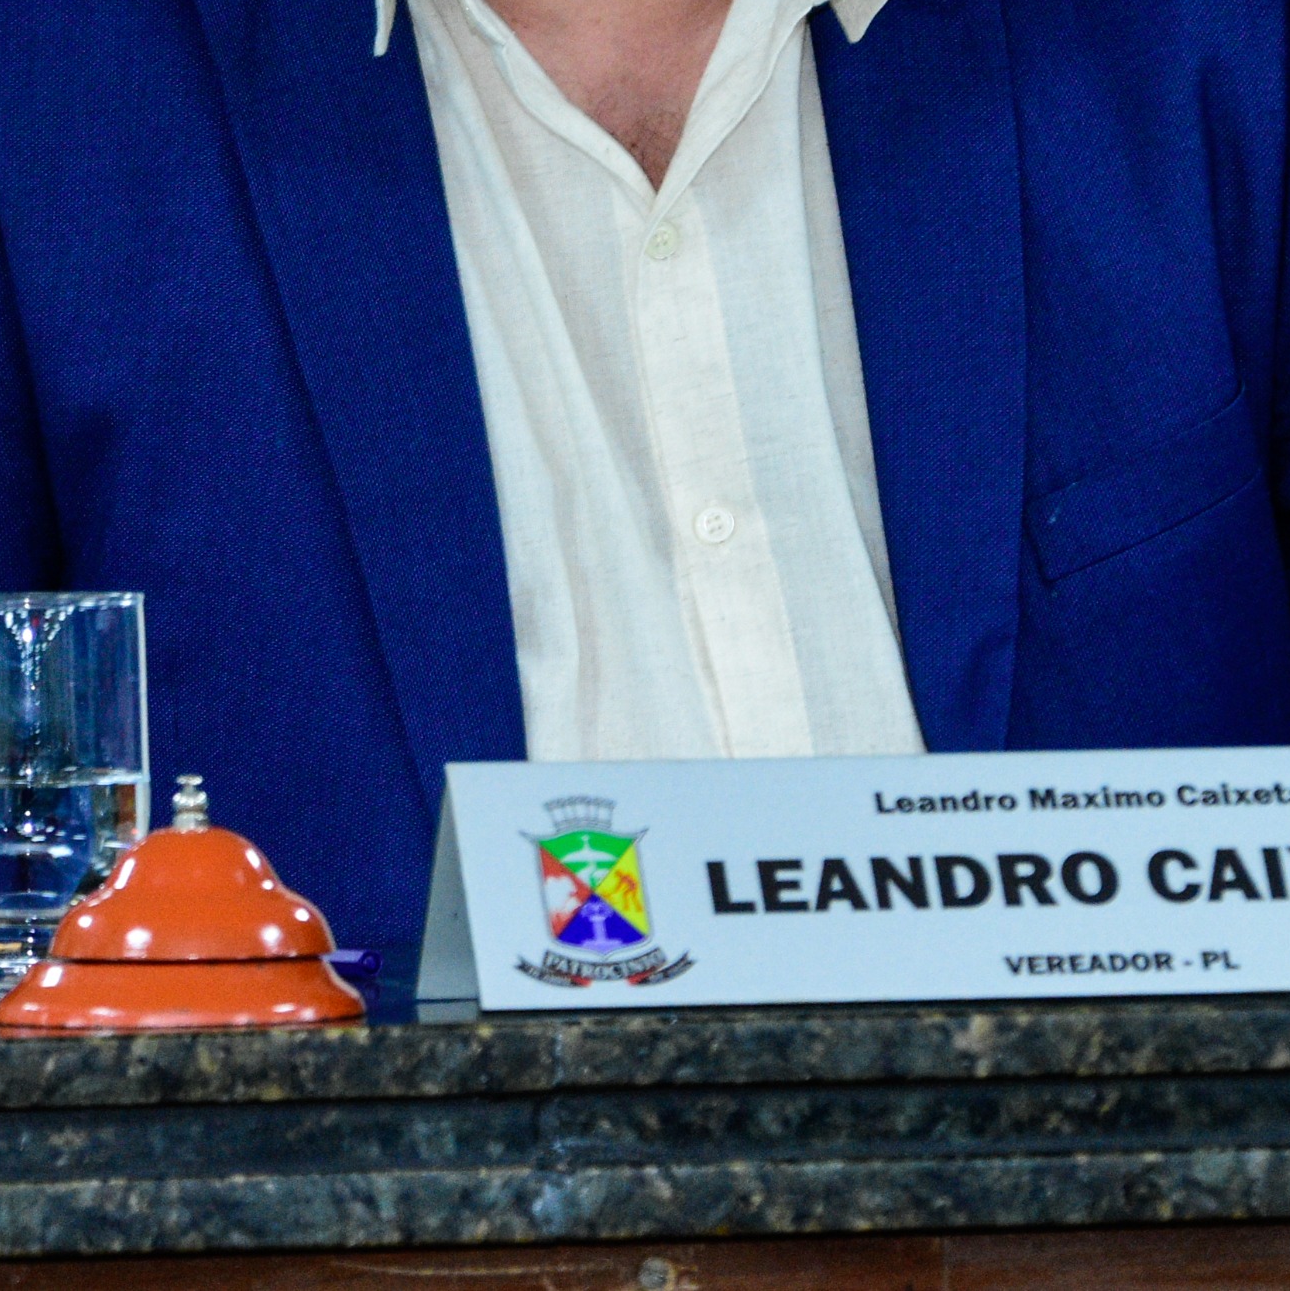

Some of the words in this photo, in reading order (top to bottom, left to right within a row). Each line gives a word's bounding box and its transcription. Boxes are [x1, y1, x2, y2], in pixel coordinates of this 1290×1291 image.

[874, 790, 1016, 814] Leandro
[1029, 786, 1166, 811] Maximo
[706, 852, 1120, 914] LEANDRO
[1004, 953, 1173, 975] VEREADOR
[1202, 951, 1241, 972] PL
